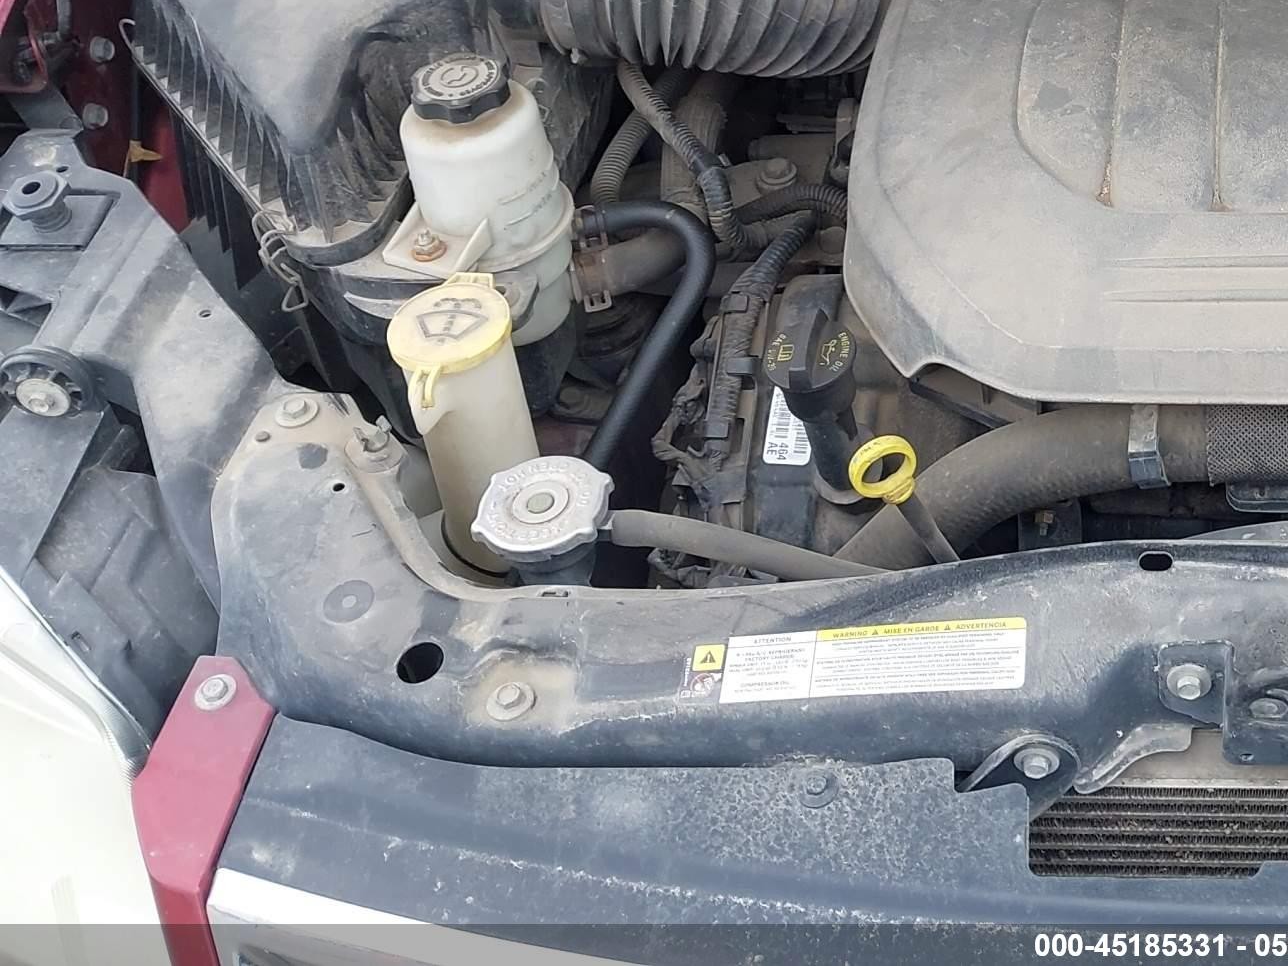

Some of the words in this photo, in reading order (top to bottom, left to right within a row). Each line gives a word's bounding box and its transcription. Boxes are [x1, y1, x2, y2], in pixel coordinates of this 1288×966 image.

[838, 331, 850, 359] ENGINE
[829, 360, 845, 372] OIL
[766, 441, 779, 455] AE
[883, 627, 902, 635] MISE
[903, 626, 914, 634] EN
[914, 625, 940, 633] GARDE
[955, 621, 1007, 631] ADVERTENCIA
[832, 630, 868, 638] WARNING
[754, 636, 792, 644] ATTENTION
